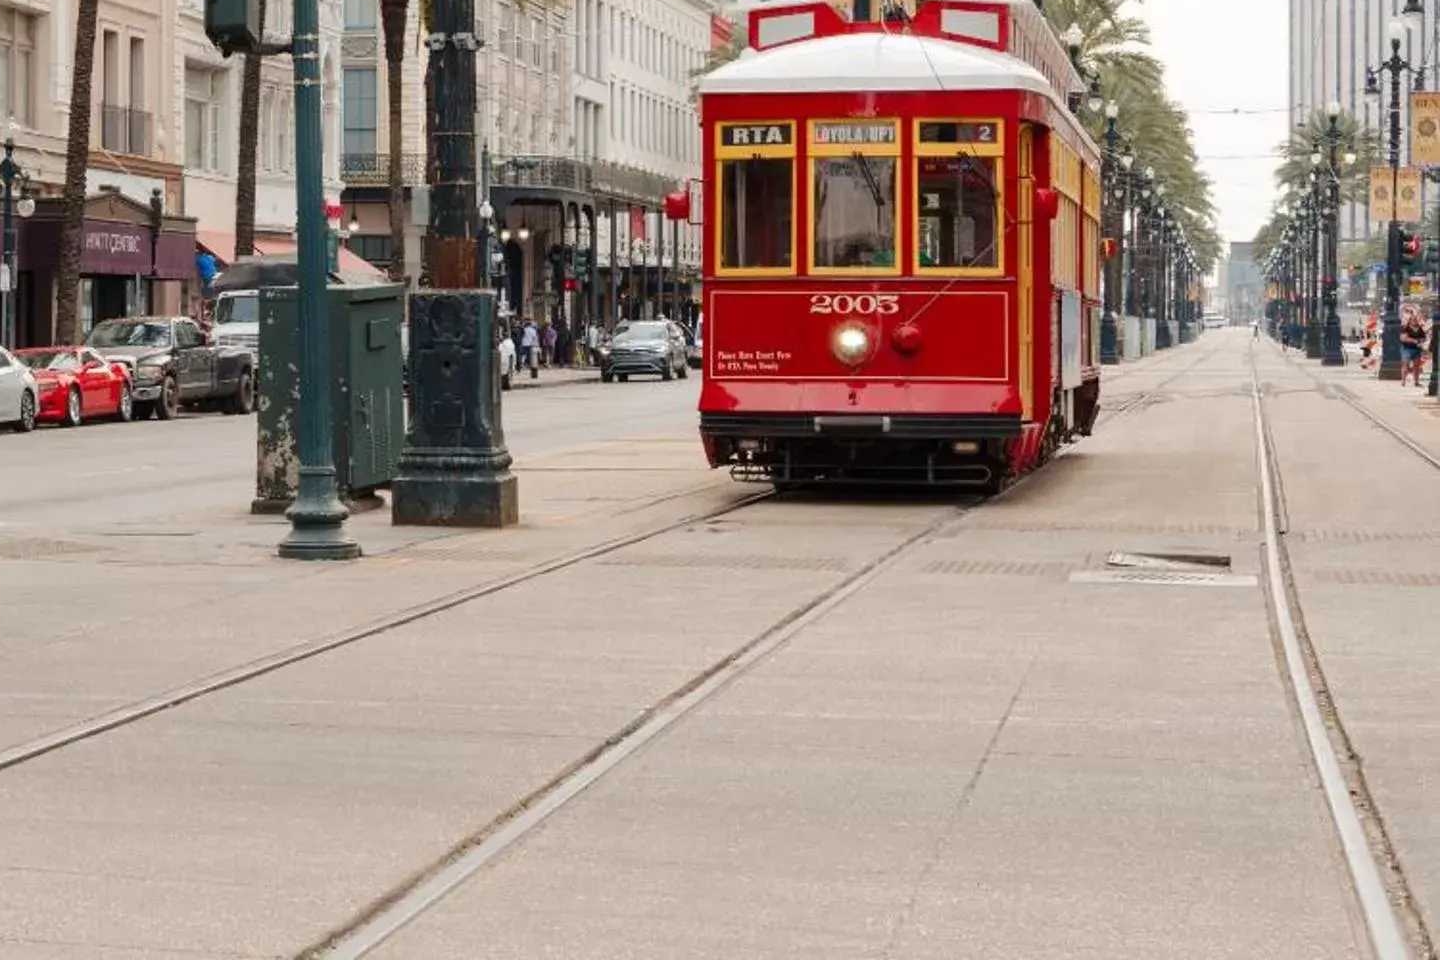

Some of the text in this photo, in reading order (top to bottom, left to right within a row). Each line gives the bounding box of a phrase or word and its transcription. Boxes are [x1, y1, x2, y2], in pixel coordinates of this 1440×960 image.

[732, 125, 784, 145] RTA
[978, 125, 993, 141] 2
[810, 294, 900, 315] 2005
